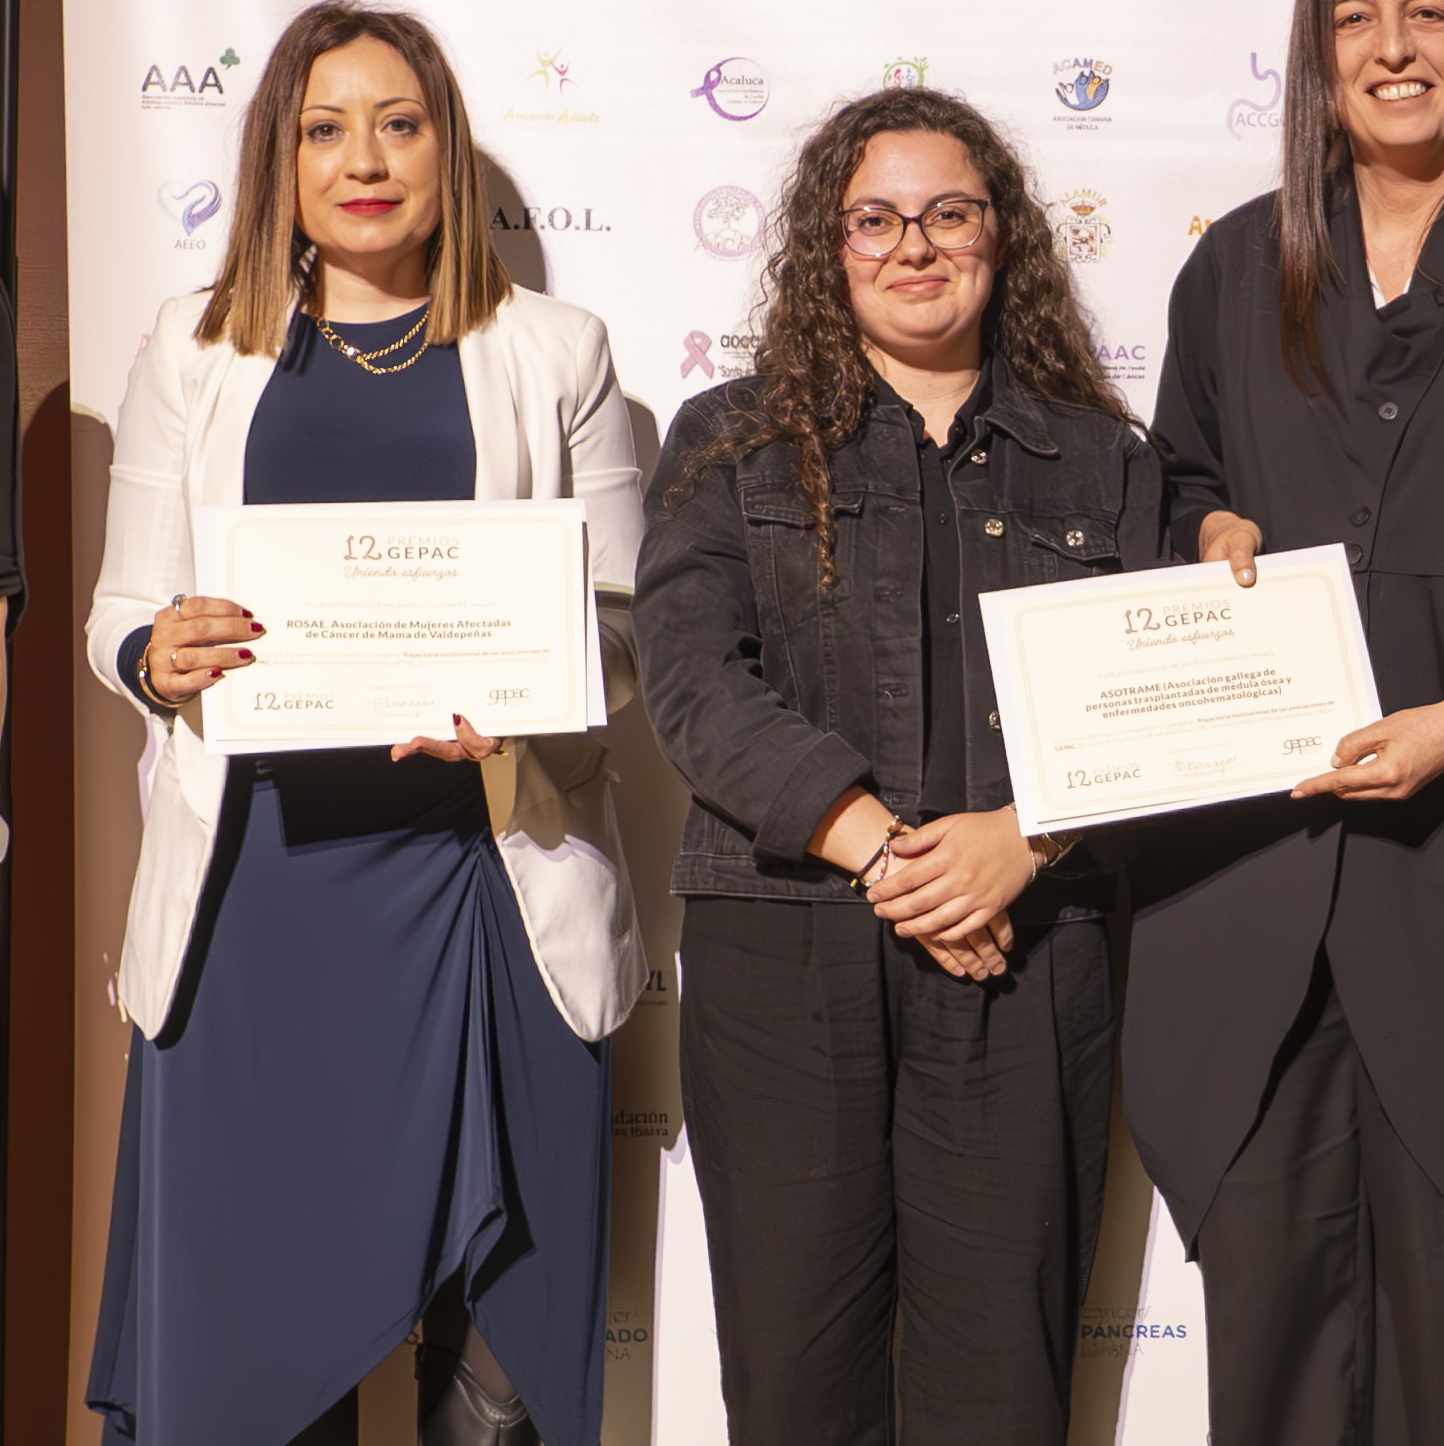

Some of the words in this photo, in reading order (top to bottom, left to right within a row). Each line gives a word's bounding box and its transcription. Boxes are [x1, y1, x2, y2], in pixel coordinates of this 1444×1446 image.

[1052, 57, 1114, 76] ACAMED
[141, 63, 225, 95] AAA
[719, 74, 765, 86] Acaluca
[1235, 111, 1284, 128] ACCG
[490, 206, 612, 232] A.F.O.L.
[1092, 344, 1146, 361] AAC
[343, 534, 383, 561] 12
[387, 535, 460, 546] PREMIOS
[387, 546, 460, 560] GEPAC
[343, 565, 399, 579] Uniendo
[401, 566, 460, 582] esfuerzos
[1163, 598, 1231, 615] PREMIOS
[331, 619, 393, 629] Asociación
[394, 619, 407, 629] de
[409, 619, 455, 631] Mujeres
[456, 618, 512, 629] Afectadas
[1124, 608, 1161, 635] 12
[1164, 608, 1233, 628] GEPAC
[305, 629, 319, 639] de
[320, 628, 361, 639] Cáncer
[362, 629, 376, 639] de
[378, 629, 412, 639] Mama
[413, 629, 427, 639] de
[428, 628, 493, 641] Valdepeñas
[1126, 634, 1179, 652] Uniendo
[1180, 629, 1236, 645] esfuerzos
[1100, 682, 1162, 699] ASOTRAME
[1163, 674, 1224, 692] (Asociación
[1225, 669, 1262, 684] gallega
[1263, 667, 1276, 677] de
[253, 691, 281, 712] 12
[1085, 699, 1133, 714] personas
[1134, 685, 1206, 705] trasplantadas
[1207, 684, 1220, 695] de
[1221, 678, 1260, 692] médula
[1261, 674, 1285, 688] ósea
[1284, 676, 1292, 687] y
[1102, 701, 1177, 720] enfermedades
[1178, 686, 1283, 709] oncohematológicas)
[284, 698, 334, 710] GEPAC
[1066, 769, 1092, 790] 12
[1094, 768, 1142, 784] GEPAC
[611, 1109, 668, 1125] dación
[1081, 1322, 1188, 1340] PÁNCREAS
